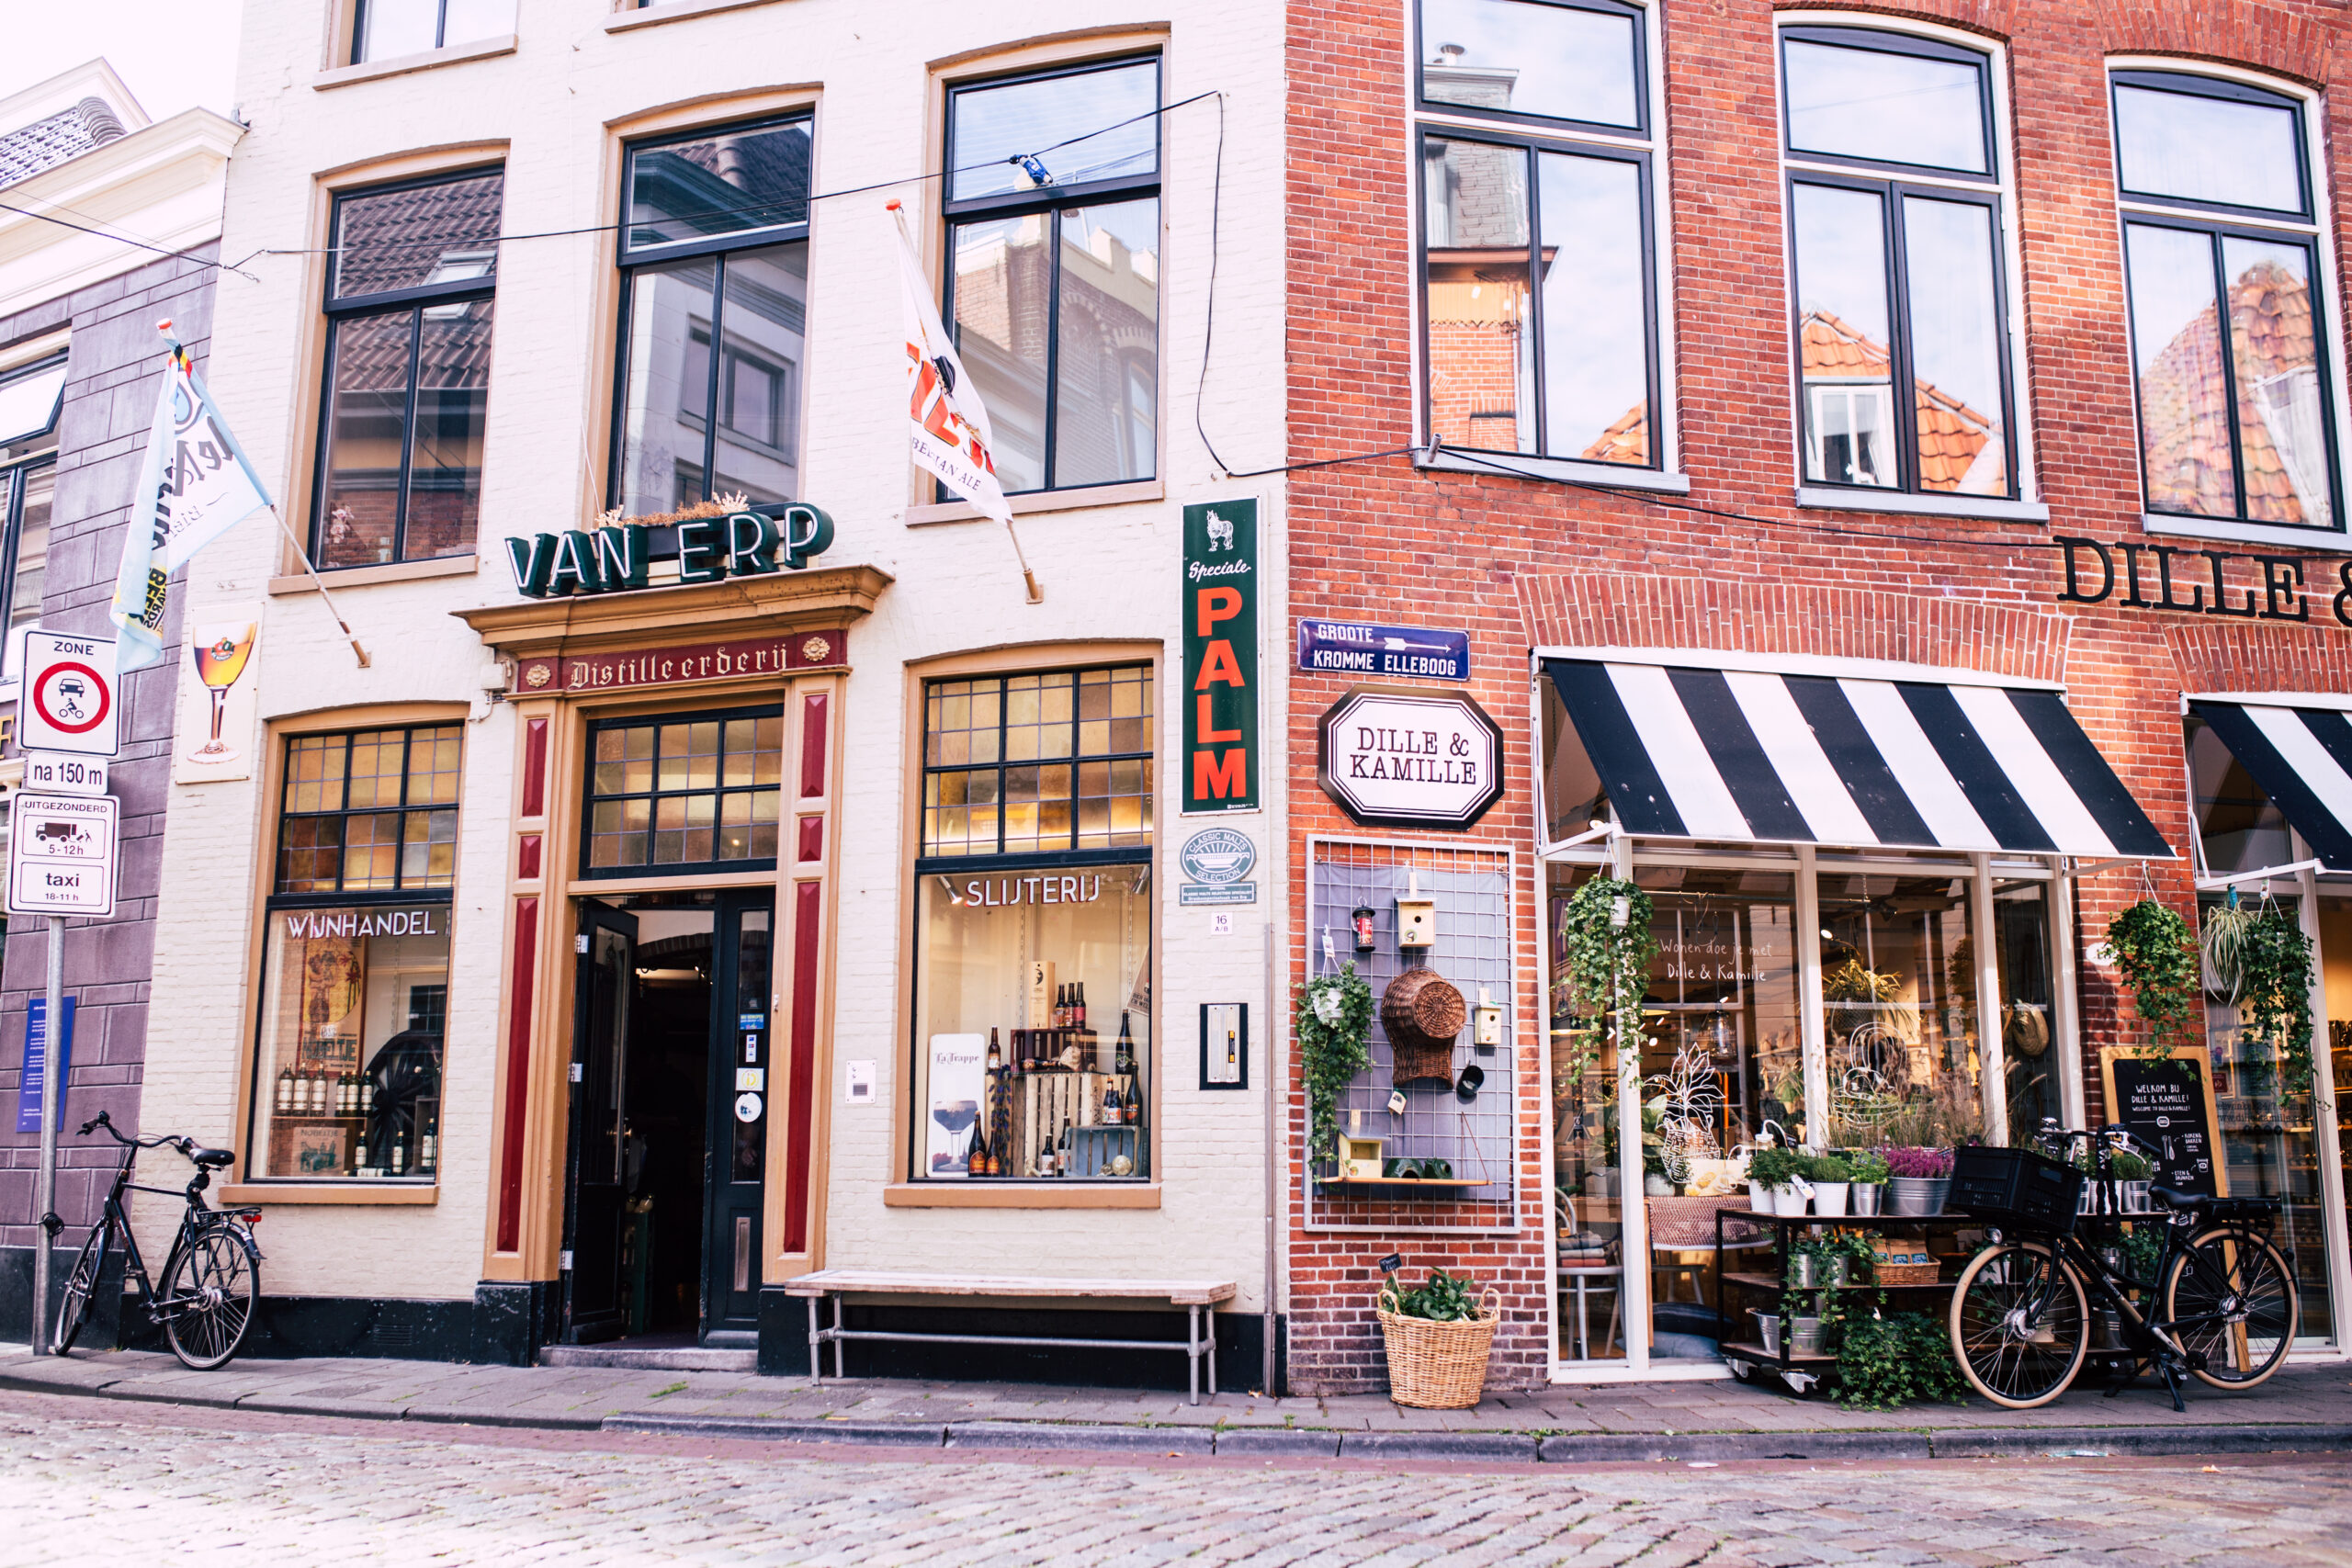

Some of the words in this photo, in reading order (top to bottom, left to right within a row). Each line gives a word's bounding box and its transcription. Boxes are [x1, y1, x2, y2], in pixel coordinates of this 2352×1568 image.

[958, 469, 981, 491] ALE
[504, 524, 649, 599] VAN
[676, 502, 835, 583] ERP
[1188, 558, 1251, 583] Speciale
[2052, 535, 2309, 623] DILLE
[1317, 624, 1374, 643] GROOTE
[53, 641, 95, 657] ZONE
[1313, 650, 1375, 671] KROMME
[1384, 654, 1457, 676] ELLEBOOG
[1193, 586, 1248, 801] PALM
[1357, 727, 1438, 755] DILLE
[1449, 732, 1470, 757] &
[34, 763, 52, 782] na
[58, 762, 85, 784] 150
[88, 769, 103, 785] m
[1350, 754, 1476, 785] KAMILLE
[25, 801, 107, 814] UITGEZONDERD
[1189, 832, 1221, 852] CLASSIC
[1223, 832, 1248, 851] MALTS
[45, 873, 80, 887] taxi
[1195, 867, 1241, 882] SELECTION
[965, 874, 1101, 908] SLIJTERIJ
[287, 911, 437, 939] WIJNHANDEL
[1216, 915, 1227, 925] 16
[1660, 938, 1701, 953] Wonen
[1706, 939, 1727, 954] doe
[1728, 942, 1744, 965] je
[1749, 942, 1772, 957] met
[1668, 962, 1695, 979] Dille
[1700, 964, 1712, 980] &
[1717, 963, 1767, 982] Kamille
[2132, 1095, 2148, 1103] DILLE
[2151, 1095, 2157, 1103] &
[2135, 1084, 2166, 1093] WELKOM
